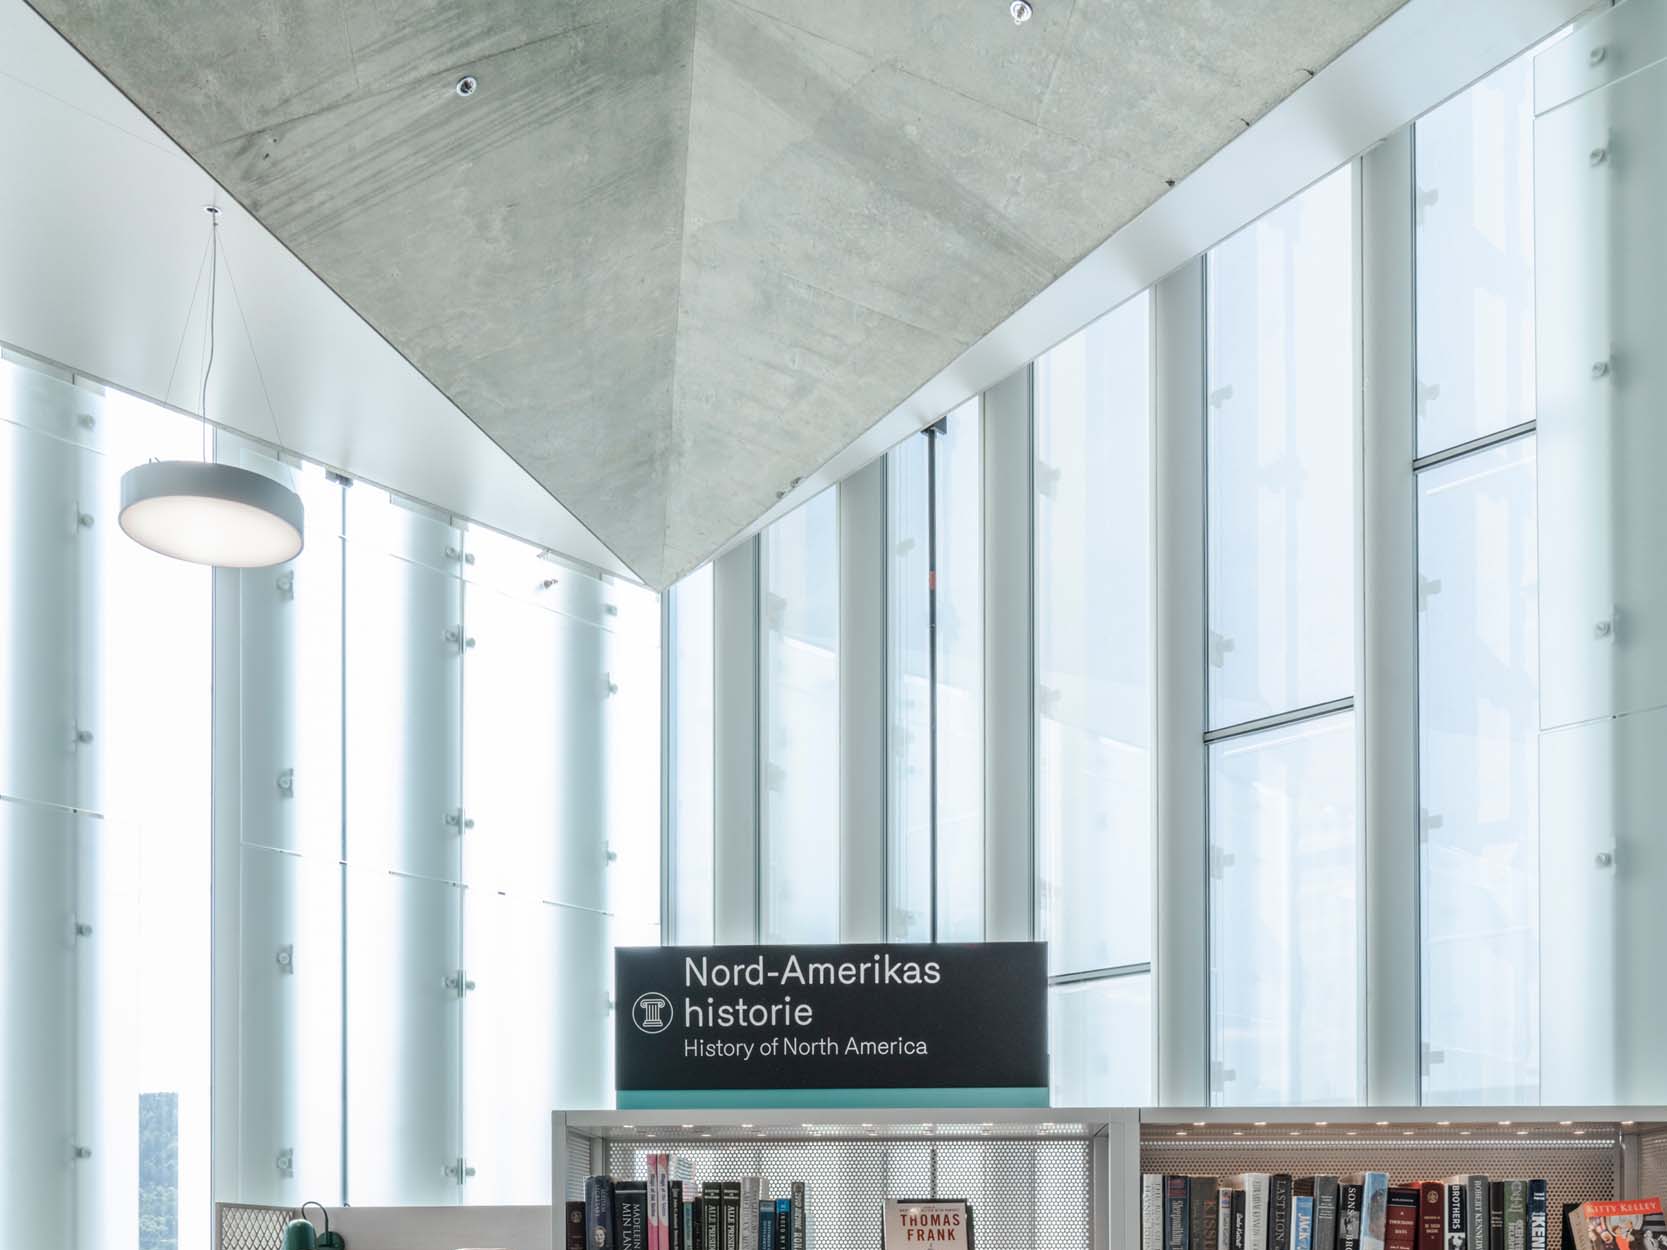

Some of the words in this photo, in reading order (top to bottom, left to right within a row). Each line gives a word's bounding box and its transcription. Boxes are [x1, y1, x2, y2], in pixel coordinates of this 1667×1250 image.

[685, 954, 940, 987] Nord-Amerikas
[684, 996, 813, 1027] historie
[684, 1039, 753, 1060] History
[759, 1038, 779, 1056] of
[783, 1037, 838, 1056] North
[844, 1037, 928, 1056] America
[1276, 1180, 1286, 1208] LAST
[1347, 1187, 1357, 1215] SONS
[1452, 1185, 1460, 1229] BROTHERS
[1474, 1180, 1482, 1211] ROBERT
[1621, 1202, 1656, 1211] KELLEY
[622, 1203, 631, 1227] MIN
[708, 1205, 717, 1223] ALLE
[727, 1205, 736, 1223] ALLE
[900, 1214, 960, 1226] THOMAS
[1170, 1200, 1183, 1245] Sleepwalking
[1275, 1211, 1285, 1241] LION
[1298, 1213, 1309, 1240] JACK
[907, 1229, 956, 1241] FRANK
[1475, 1213, 1483, 1250] KENNEDY
